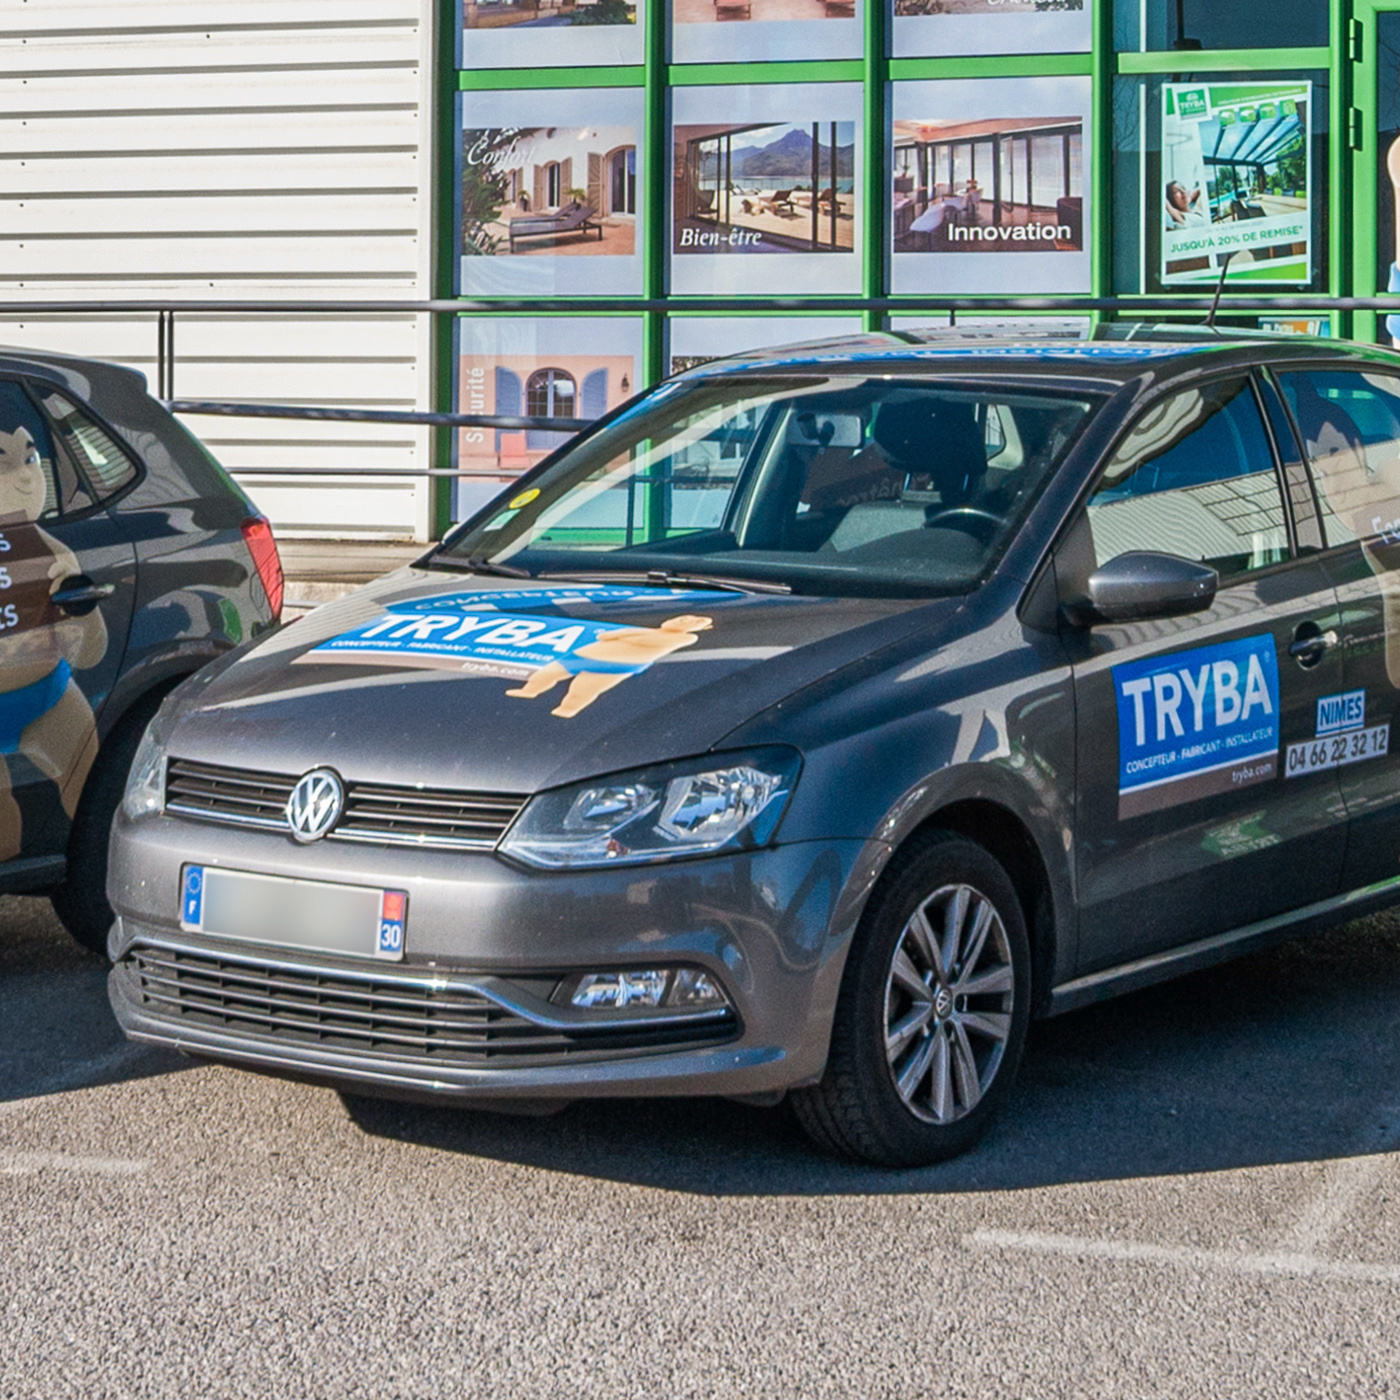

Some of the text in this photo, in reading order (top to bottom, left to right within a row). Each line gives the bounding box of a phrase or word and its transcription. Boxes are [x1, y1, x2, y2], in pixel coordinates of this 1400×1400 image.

[466, 134, 536, 167] Confort
[680, 227, 762, 246] Bien-être
[948, 222, 1072, 241] Innovation
[1218, 234, 1241, 247] 20%
[1242, 231, 1257, 243] DE
[466, 367, 484, 443] Surité
[361, 614, 585, 653] TRYBA
[1121, 653, 1273, 747] TRYBA
[1320, 698, 1362, 726] NIMES
[1126, 751, 1176, 774] CONCEPTEUR
[1181, 739, 1221, 762] FABRICANT
[1288, 728, 1386, 771] 04 66 22 32 12
[1231, 762, 1272, 784] tryba.com
[381, 923, 401, 949] 30
